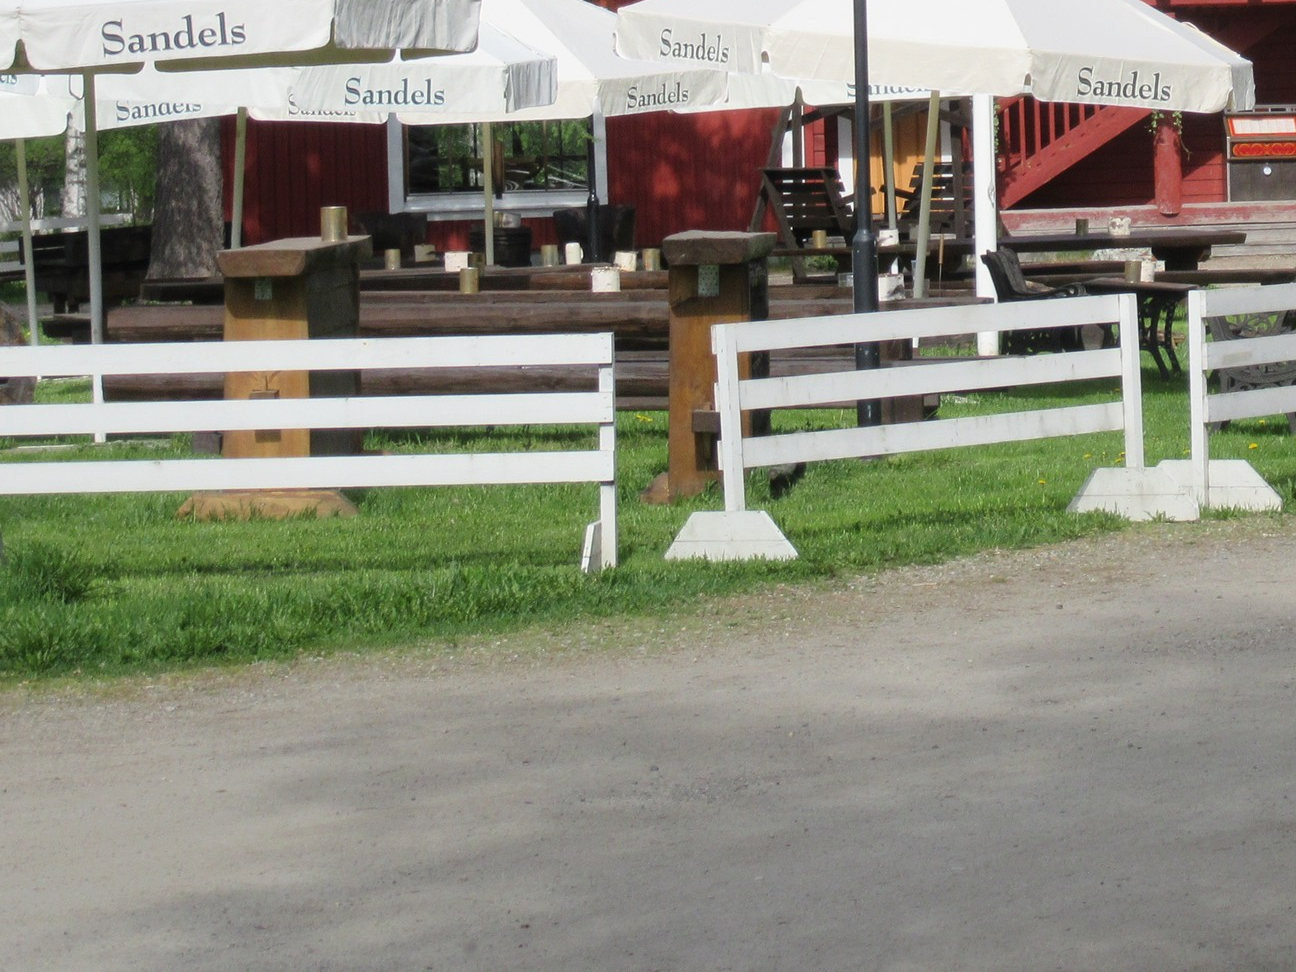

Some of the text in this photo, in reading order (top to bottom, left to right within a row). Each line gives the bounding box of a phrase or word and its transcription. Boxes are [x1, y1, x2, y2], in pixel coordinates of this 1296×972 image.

[101, 11, 247, 58] Sandels
[659, 28, 729, 64] Sandels
[344, 76, 445, 106] Sandels
[627, 81, 689, 108] Sandels
[1077, 66, 1171, 101] Sandels
